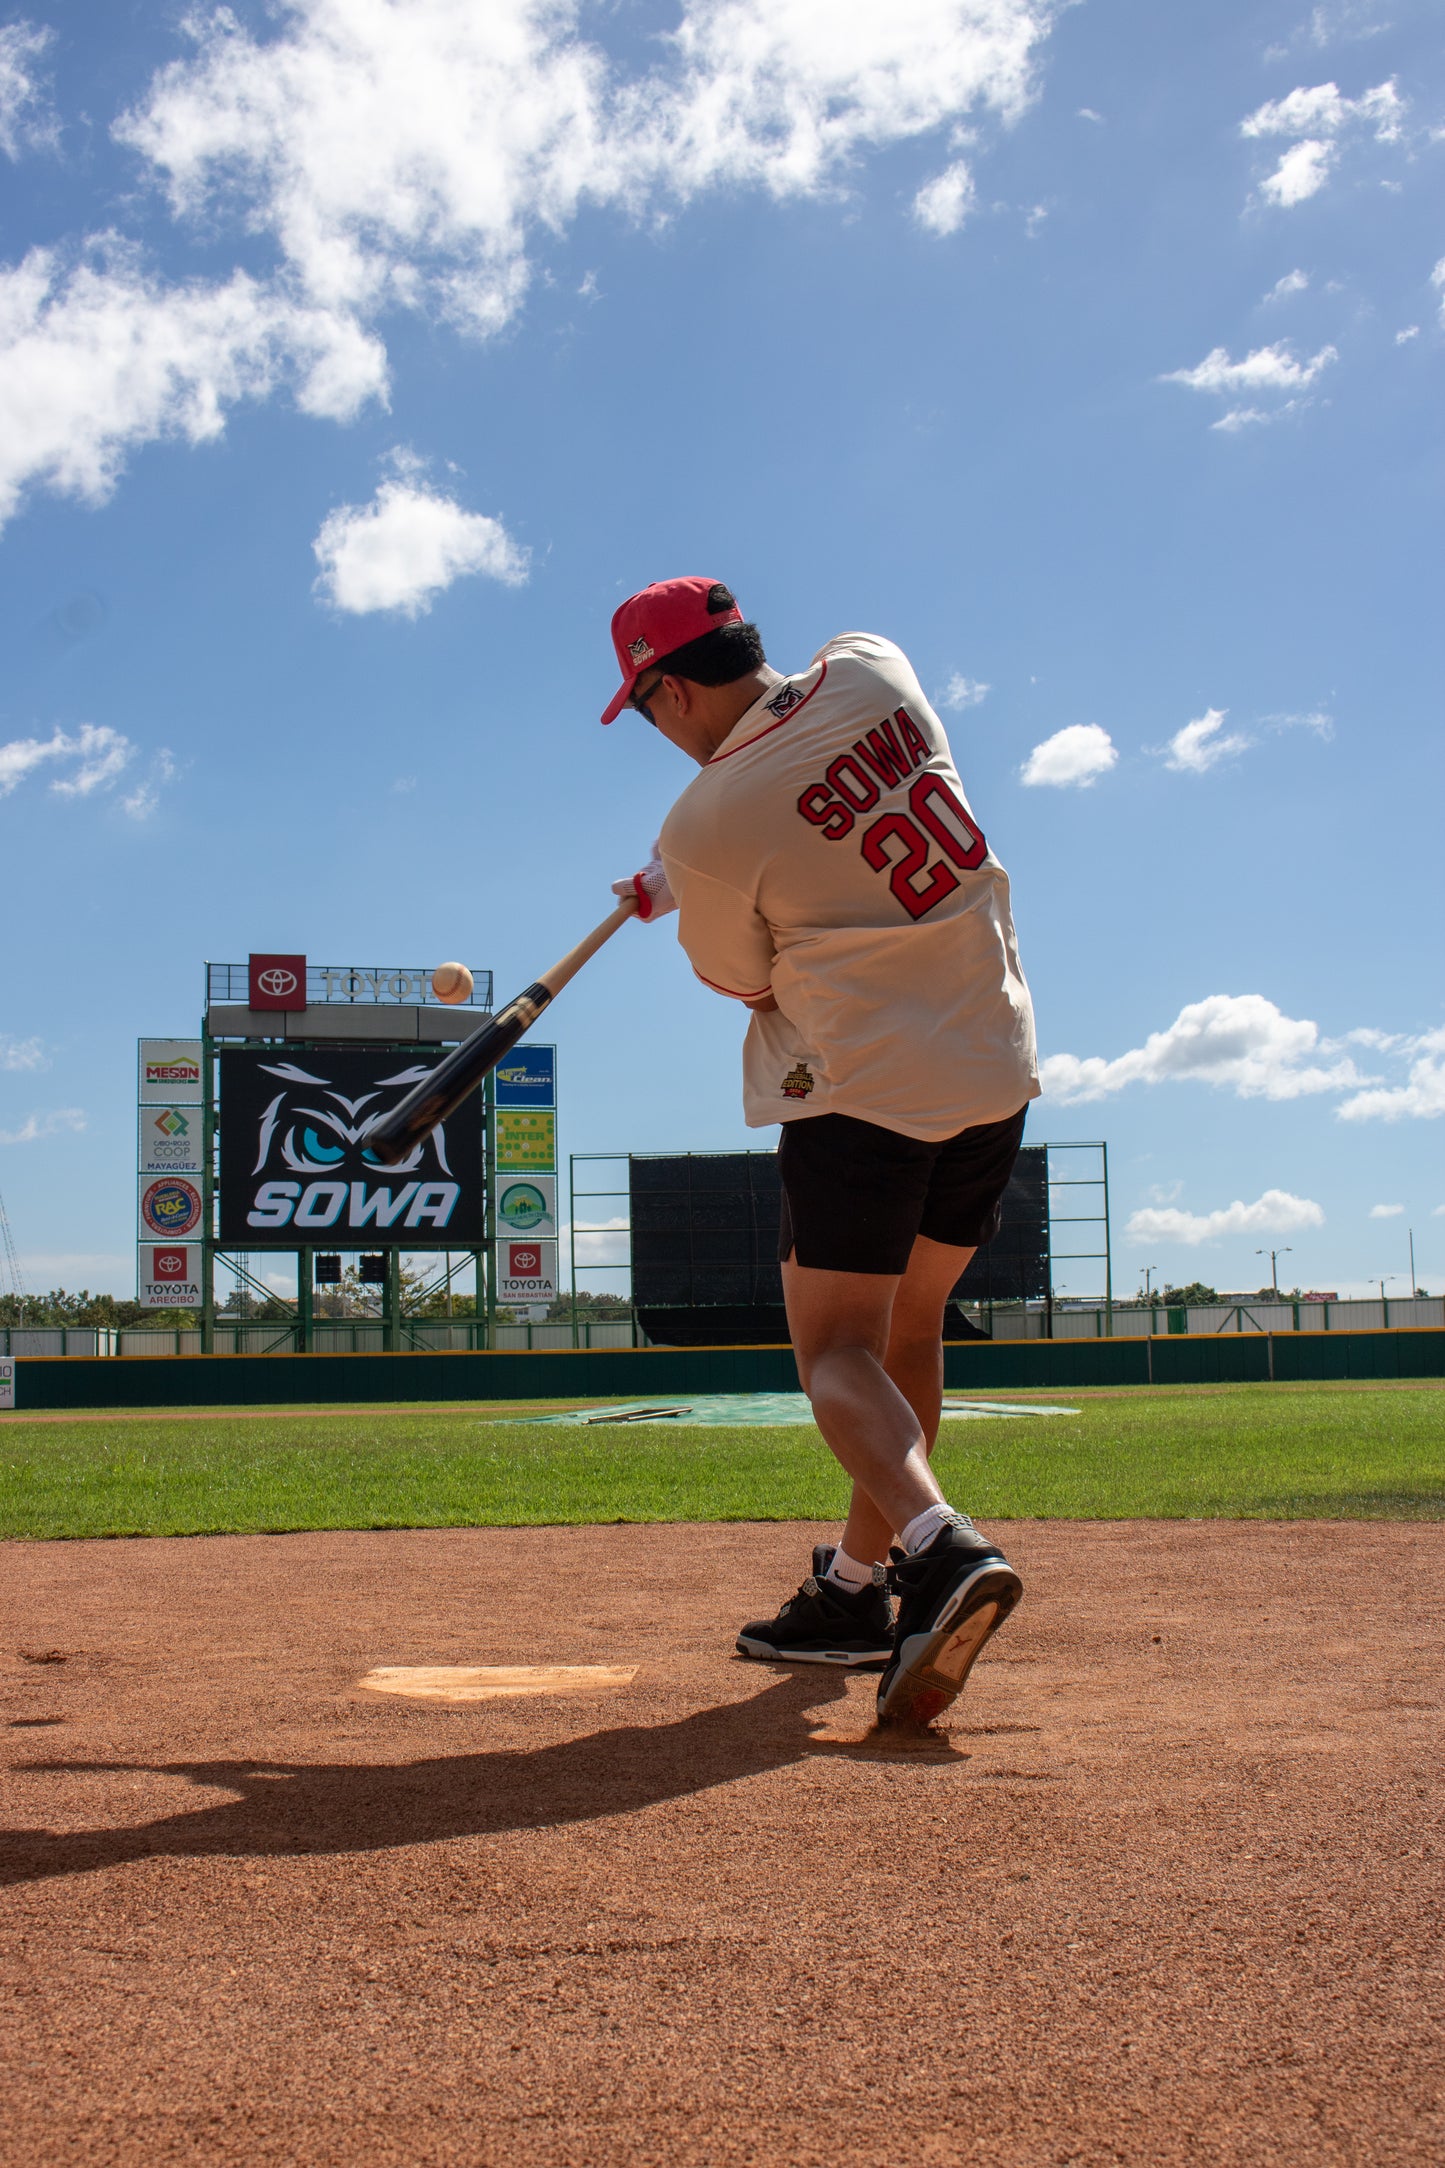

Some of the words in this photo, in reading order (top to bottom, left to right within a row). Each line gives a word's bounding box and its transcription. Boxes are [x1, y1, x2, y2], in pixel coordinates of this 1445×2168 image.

[632, 648, 655, 667] SOWA
[797, 706, 932, 841] SOWA
[861, 771, 989, 922] 20
[320, 971, 436, 1000] TOYOT
[781, 1079, 813, 1092] EDITION
[153, 1146, 191, 1157] COOP
[147, 1161, 197, 1170] MAYAGÜEZ
[155, 1197, 186, 1216] RAC
[246, 1181, 461, 1227] SOWA
[145, 1284, 199, 1295] TOYOTA
[502, 1279, 553, 1290] TOYOTA
[149, 1295, 195, 1304] ARECIBO
